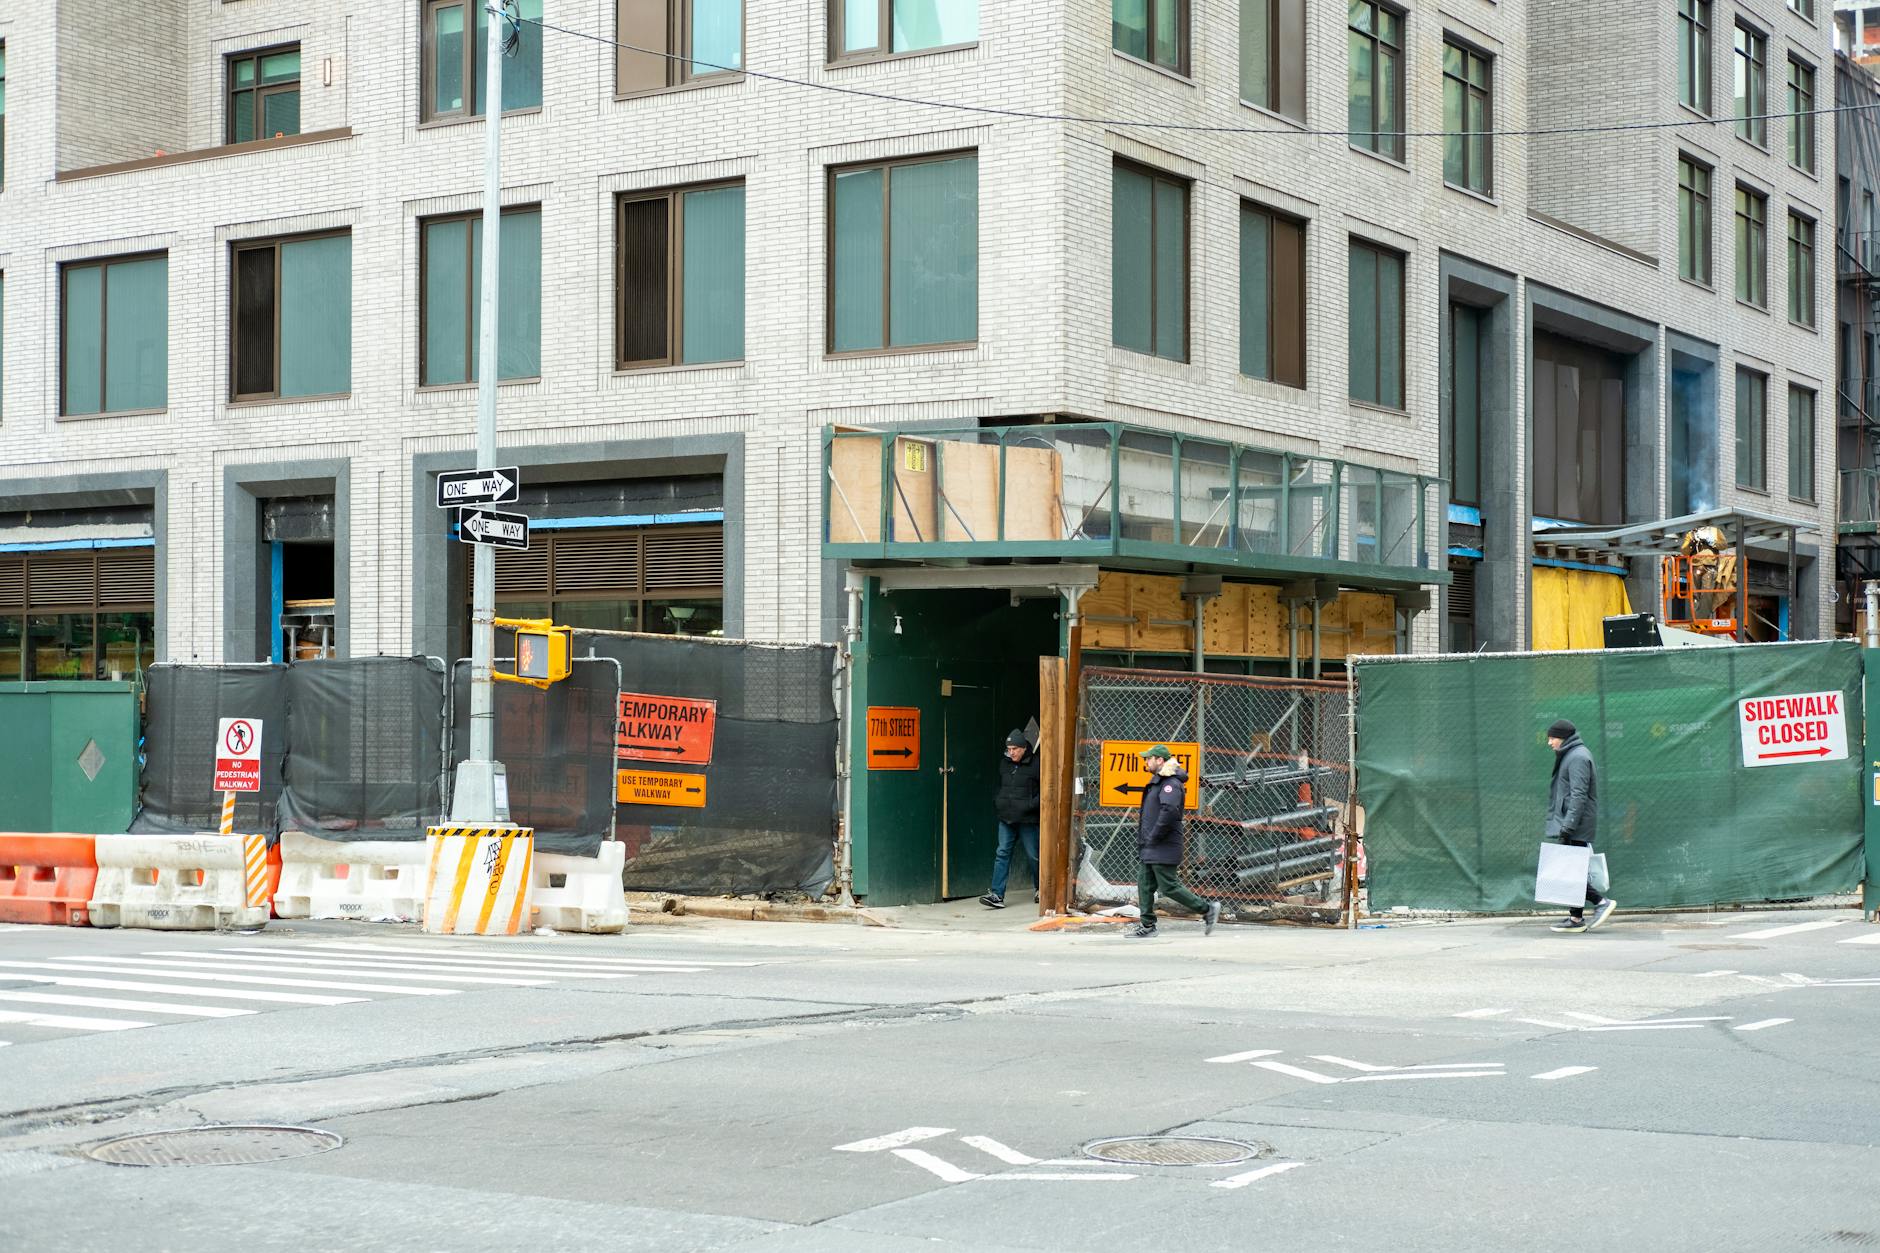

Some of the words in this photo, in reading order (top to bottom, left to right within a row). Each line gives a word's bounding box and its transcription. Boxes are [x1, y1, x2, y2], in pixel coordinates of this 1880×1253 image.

[447, 483, 467, 496] ONE
[482, 479, 504, 492] WAY
[471, 520, 490, 533] ONE
[502, 523, 521, 537] WAY
[1745, 694, 1839, 722] SIDEWALK
[617, 721, 683, 742] ALKWAY
[871, 718, 888, 736] 77th
[889, 718, 916, 736] STREET
[1758, 720, 1829, 745] CLOSED
[1109, 752, 1138, 772] 77th
[622, 775, 637, 785] USE
[638, 776, 683, 788] TEMPORARY
[634, 788, 671, 799] WALKWAY
